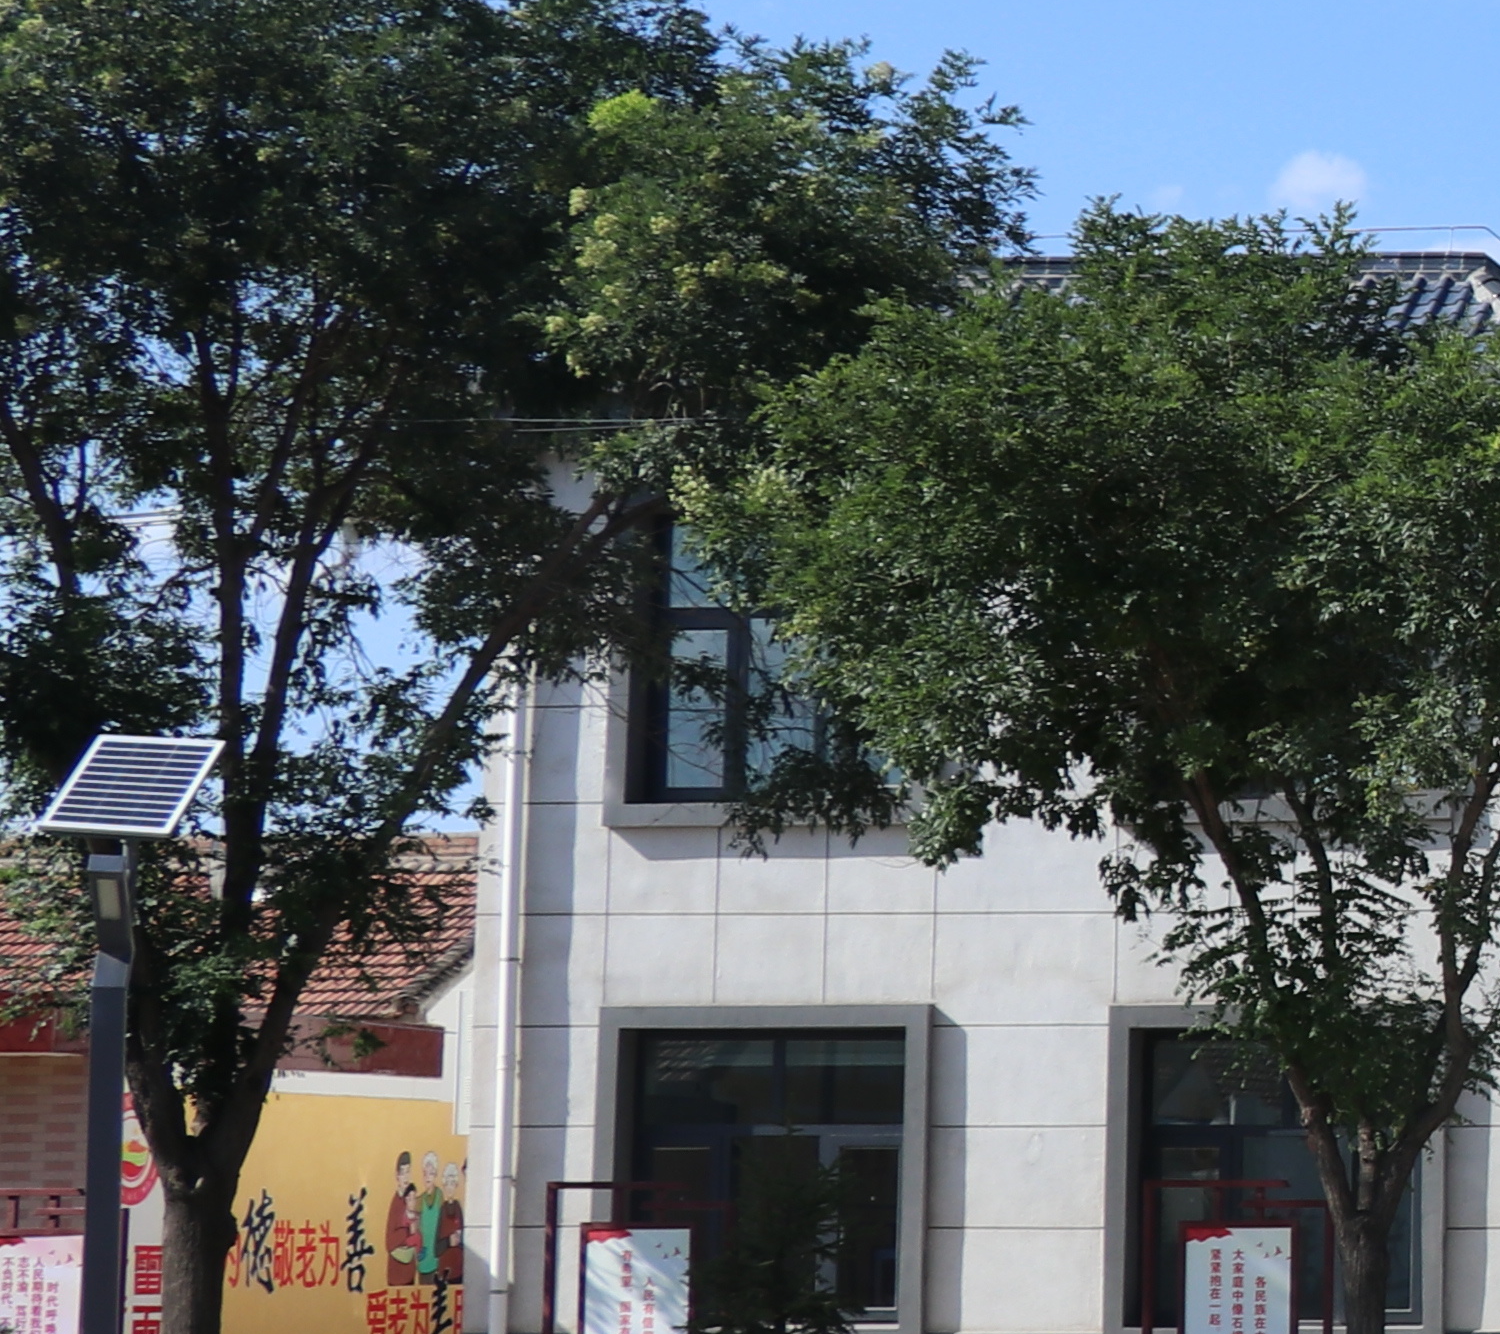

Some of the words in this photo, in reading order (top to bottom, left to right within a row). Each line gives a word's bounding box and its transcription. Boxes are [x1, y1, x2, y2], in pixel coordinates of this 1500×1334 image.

[1208, 1248, 1222, 1333] 紧紧抱在一起。
